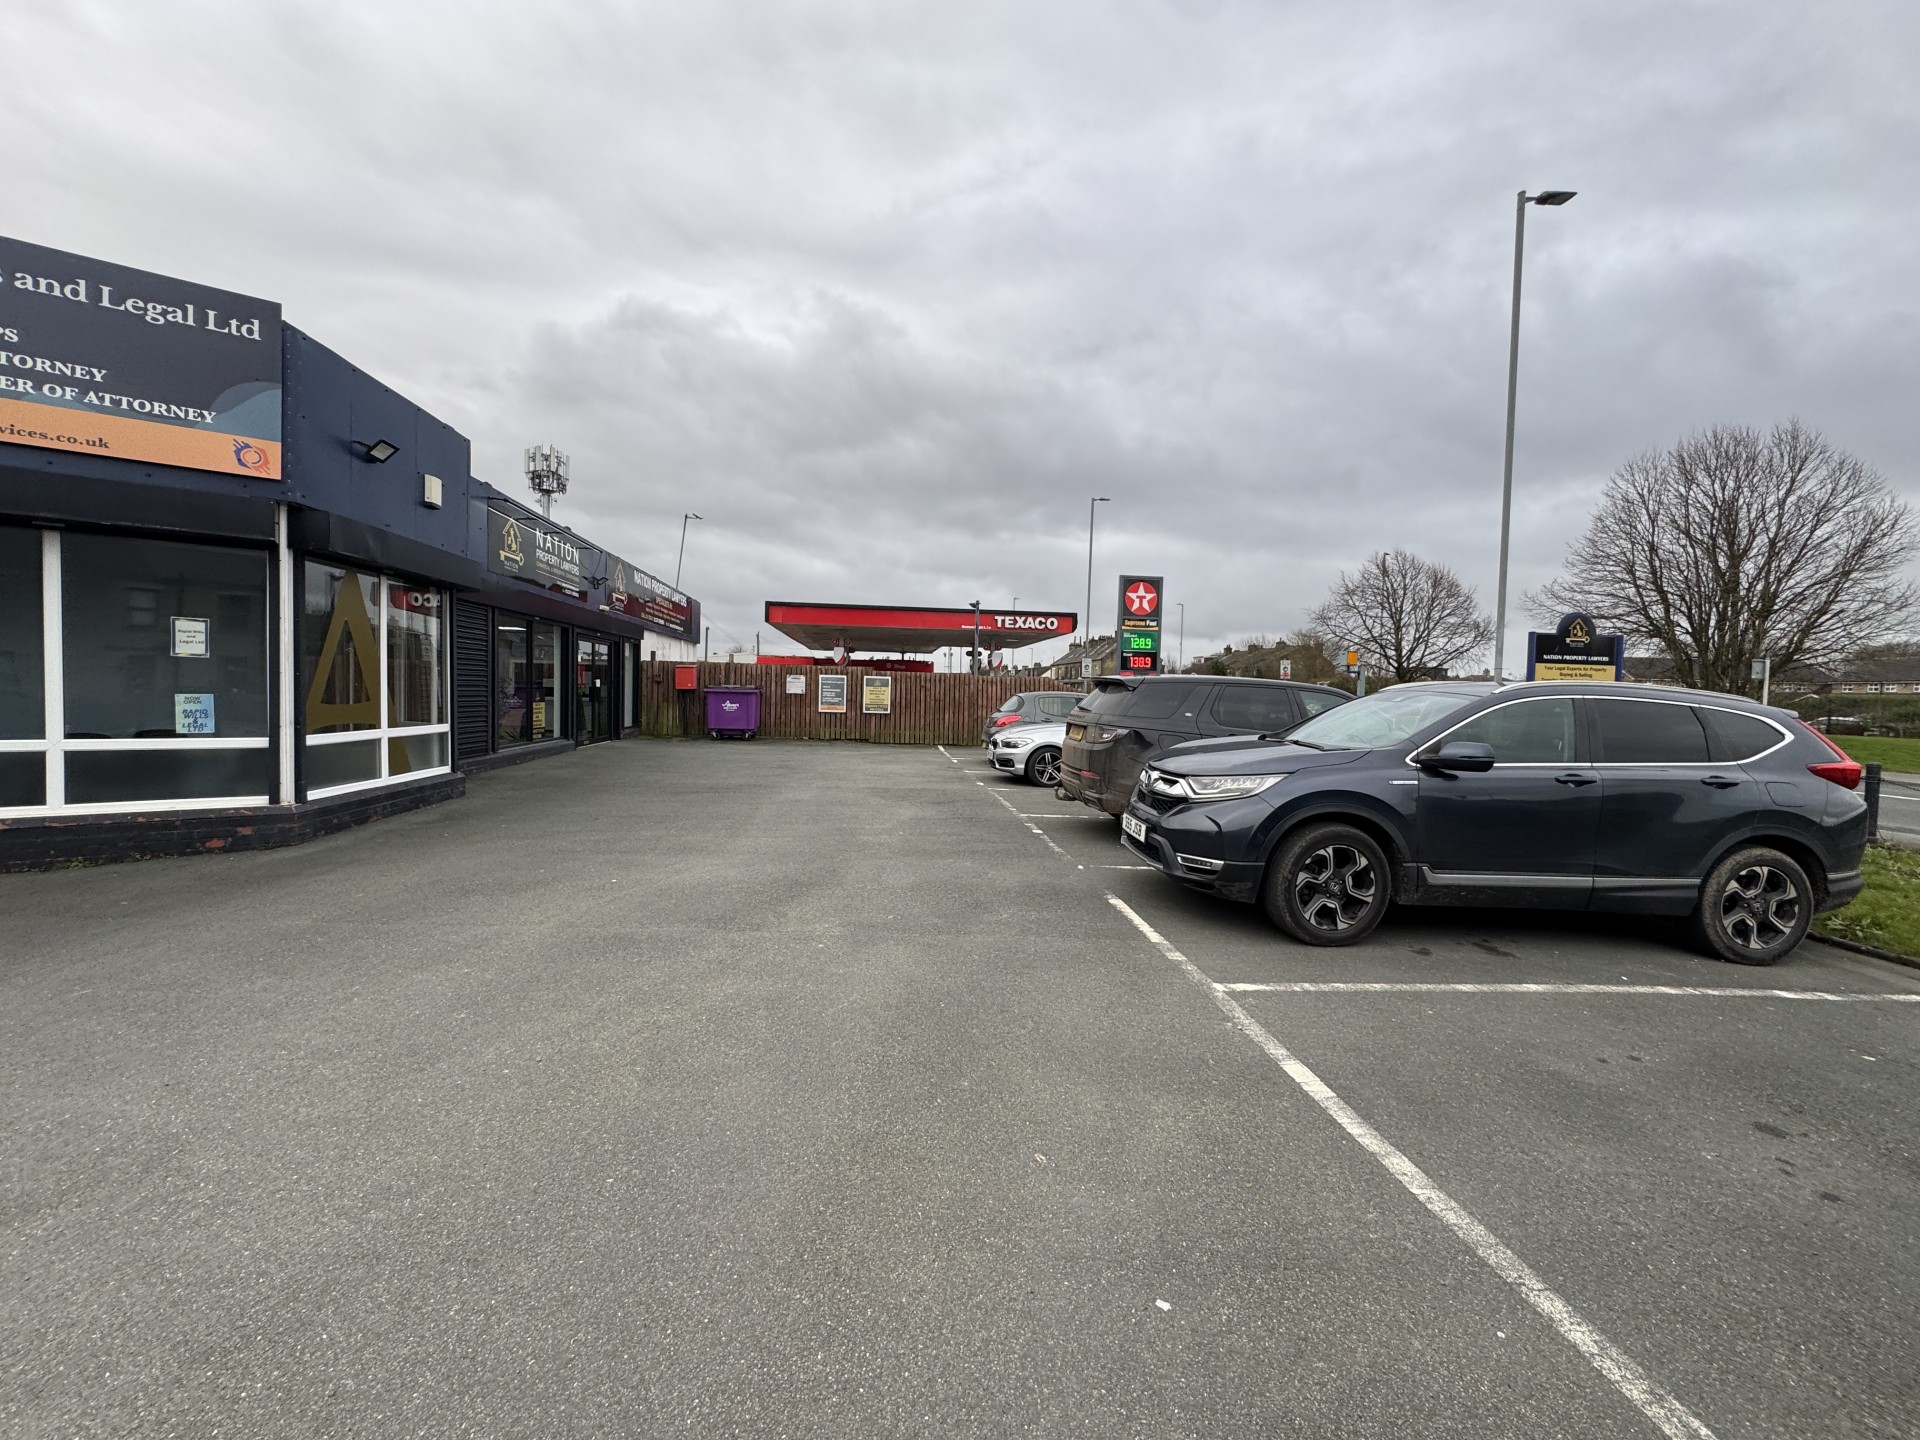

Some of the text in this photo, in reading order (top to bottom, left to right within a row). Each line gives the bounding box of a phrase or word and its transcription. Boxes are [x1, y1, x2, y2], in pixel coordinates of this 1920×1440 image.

[14, 272, 88, 303] and
[98, 285, 196, 326] Legal
[205, 309, 261, 340] Ltd
[42, 383, 78, 400] OF
[83, 390, 217, 424] ATTORNEY
[536, 527, 580, 565] NATION
[536, 548, 560, 568] PROPERTY
[560, 559, 580, 576] LAWYERS
[634, 569, 688, 608] NATION PROPERTY LAWYERS
[994, 615, 1059, 630] TEXACO
[1130, 638, 1152, 649] 128.9
[1130, 656, 1152, 668] 138.9
